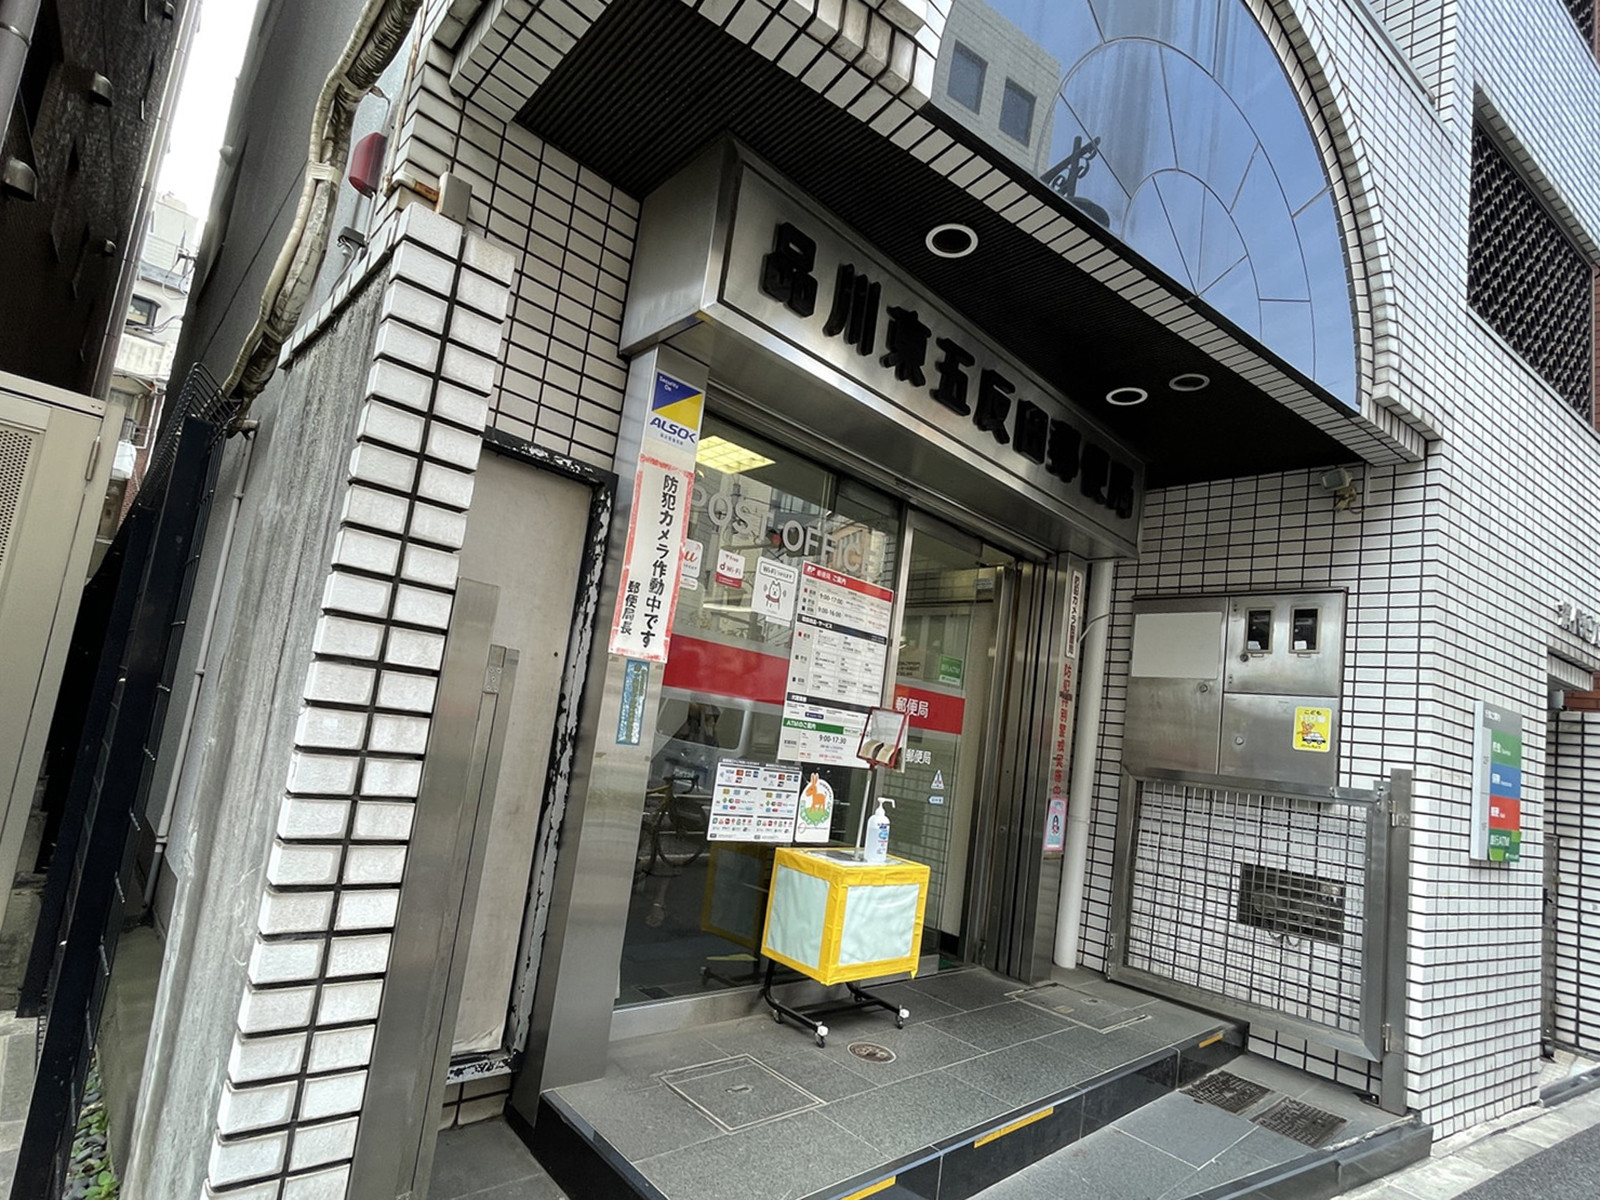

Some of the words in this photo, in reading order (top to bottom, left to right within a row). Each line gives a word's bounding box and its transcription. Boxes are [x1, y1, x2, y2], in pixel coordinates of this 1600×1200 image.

[650, 416, 697, 444] ALSOK
[640, 474, 679, 648] 防犯カメラ作動中です
[620, 580, 642, 636] 郵便局長
[895, 695, 929, 719] 郵便局
[905, 749, 932, 766] 郵便局
